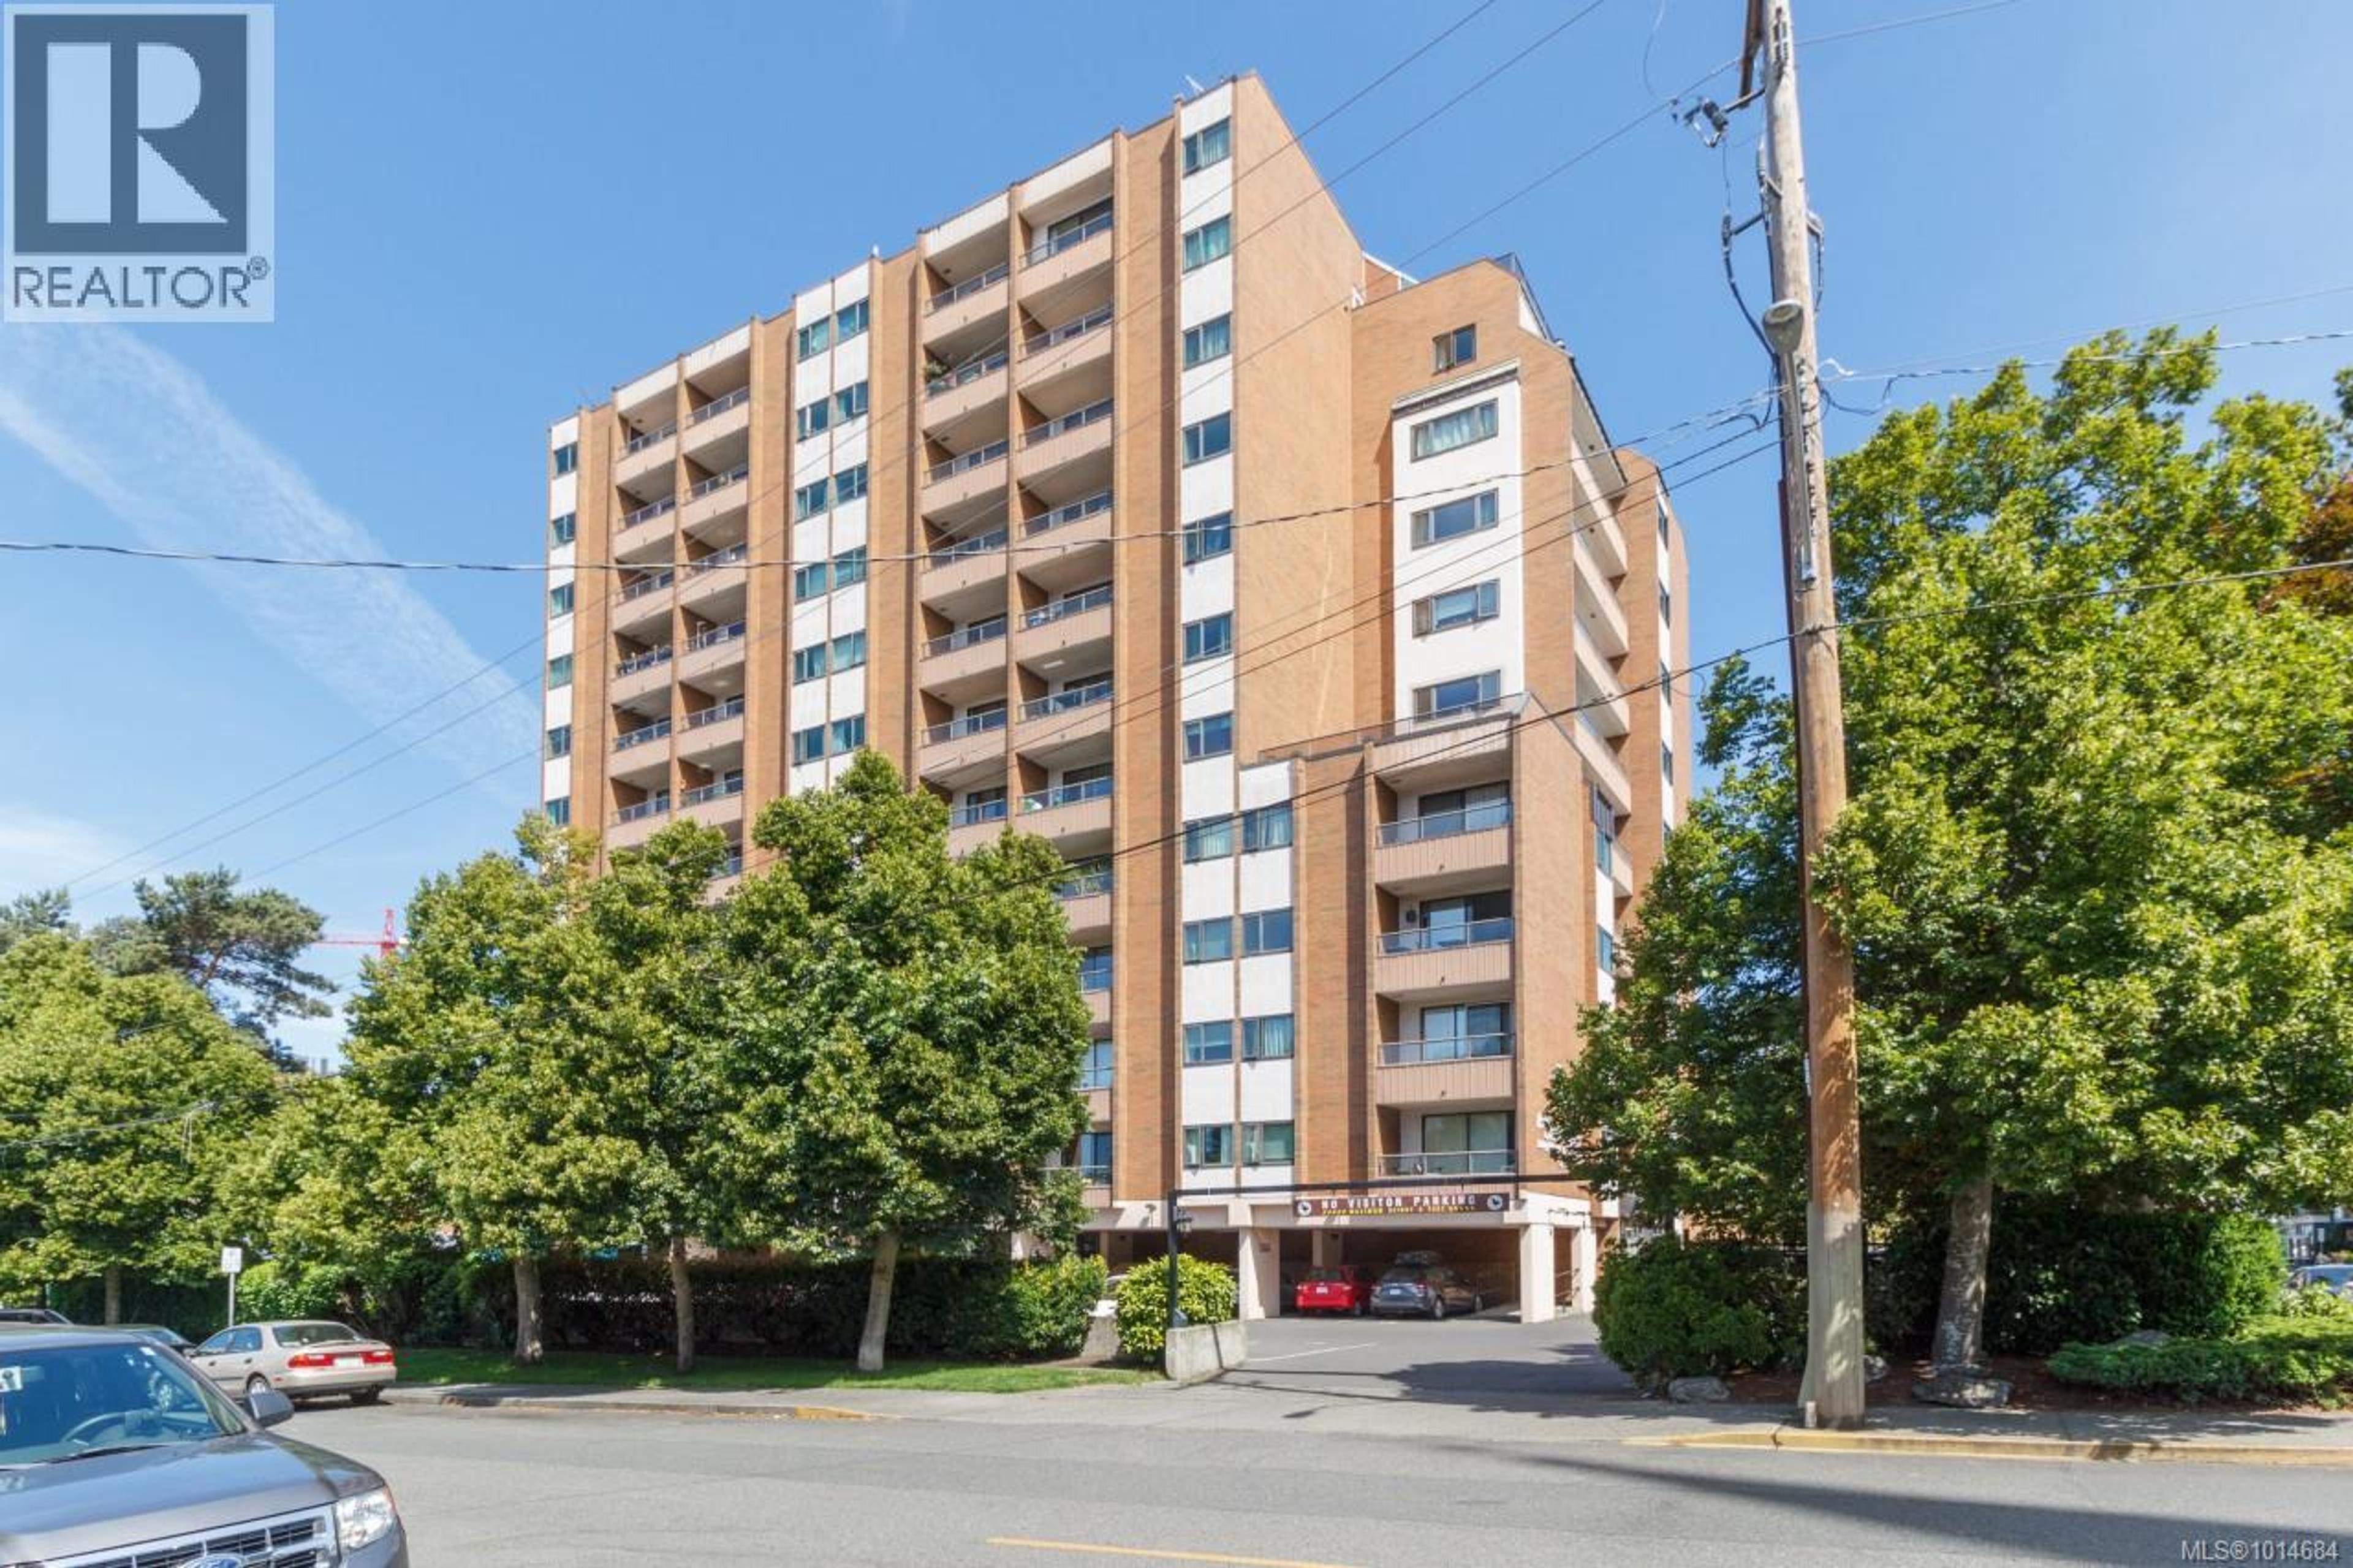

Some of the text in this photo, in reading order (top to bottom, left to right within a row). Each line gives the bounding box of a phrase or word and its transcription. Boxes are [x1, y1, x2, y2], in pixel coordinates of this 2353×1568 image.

[1322, 1195, 1476, 1209] NO VISITOR PARKING
